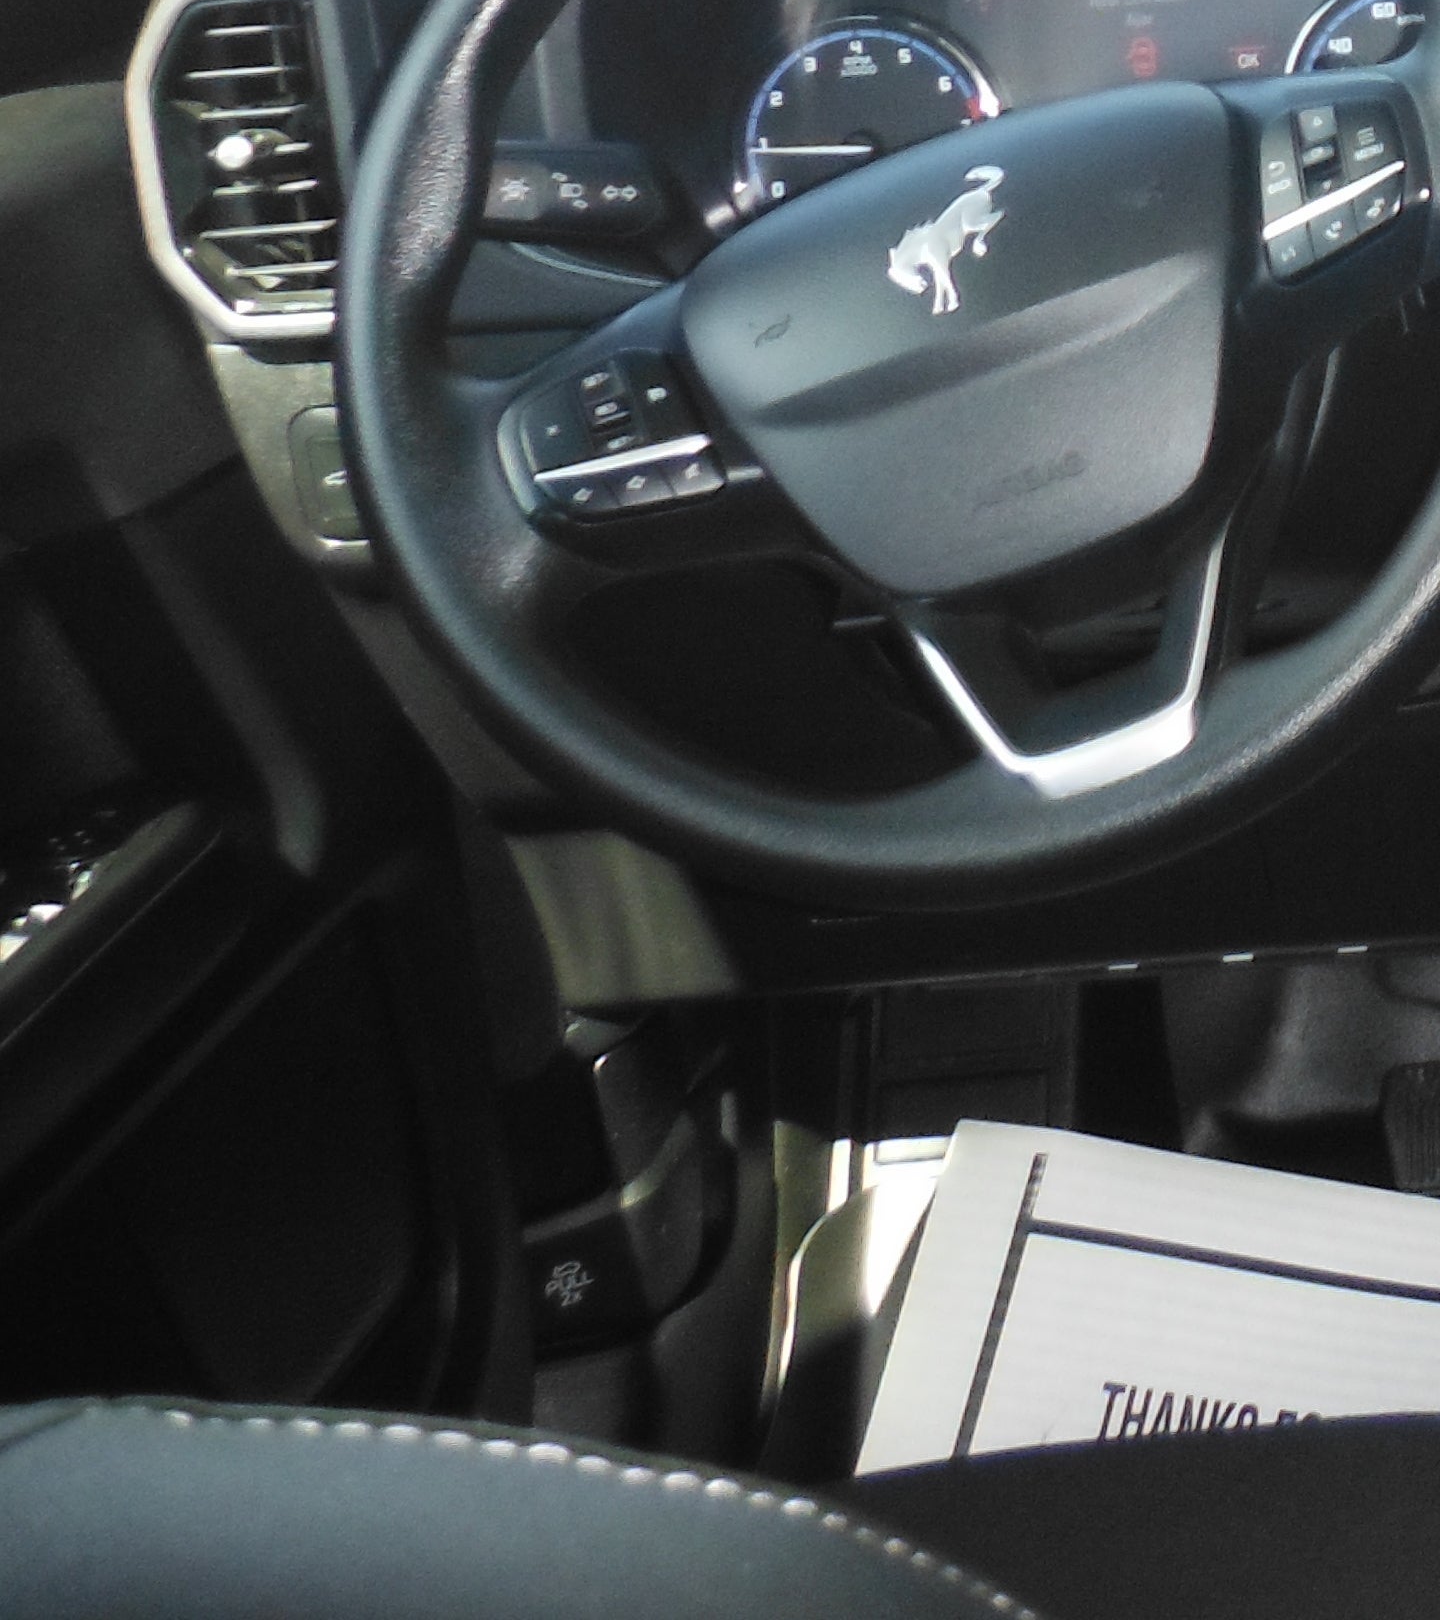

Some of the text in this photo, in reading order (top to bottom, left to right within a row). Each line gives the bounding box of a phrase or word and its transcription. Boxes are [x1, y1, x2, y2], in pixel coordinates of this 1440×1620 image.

[1371, 1, 1397, 20] 60
[849, 40, 863, 55] 4
[1327, 36, 1353, 54] 40
[803, 56, 818, 73] 3
[897, 47, 913, 65] 5
[938, 76, 953, 94] 6
[769, 90, 785, 109] 2
[771, 180, 786, 200] 0
[545, 1270, 596, 1297] PULL
